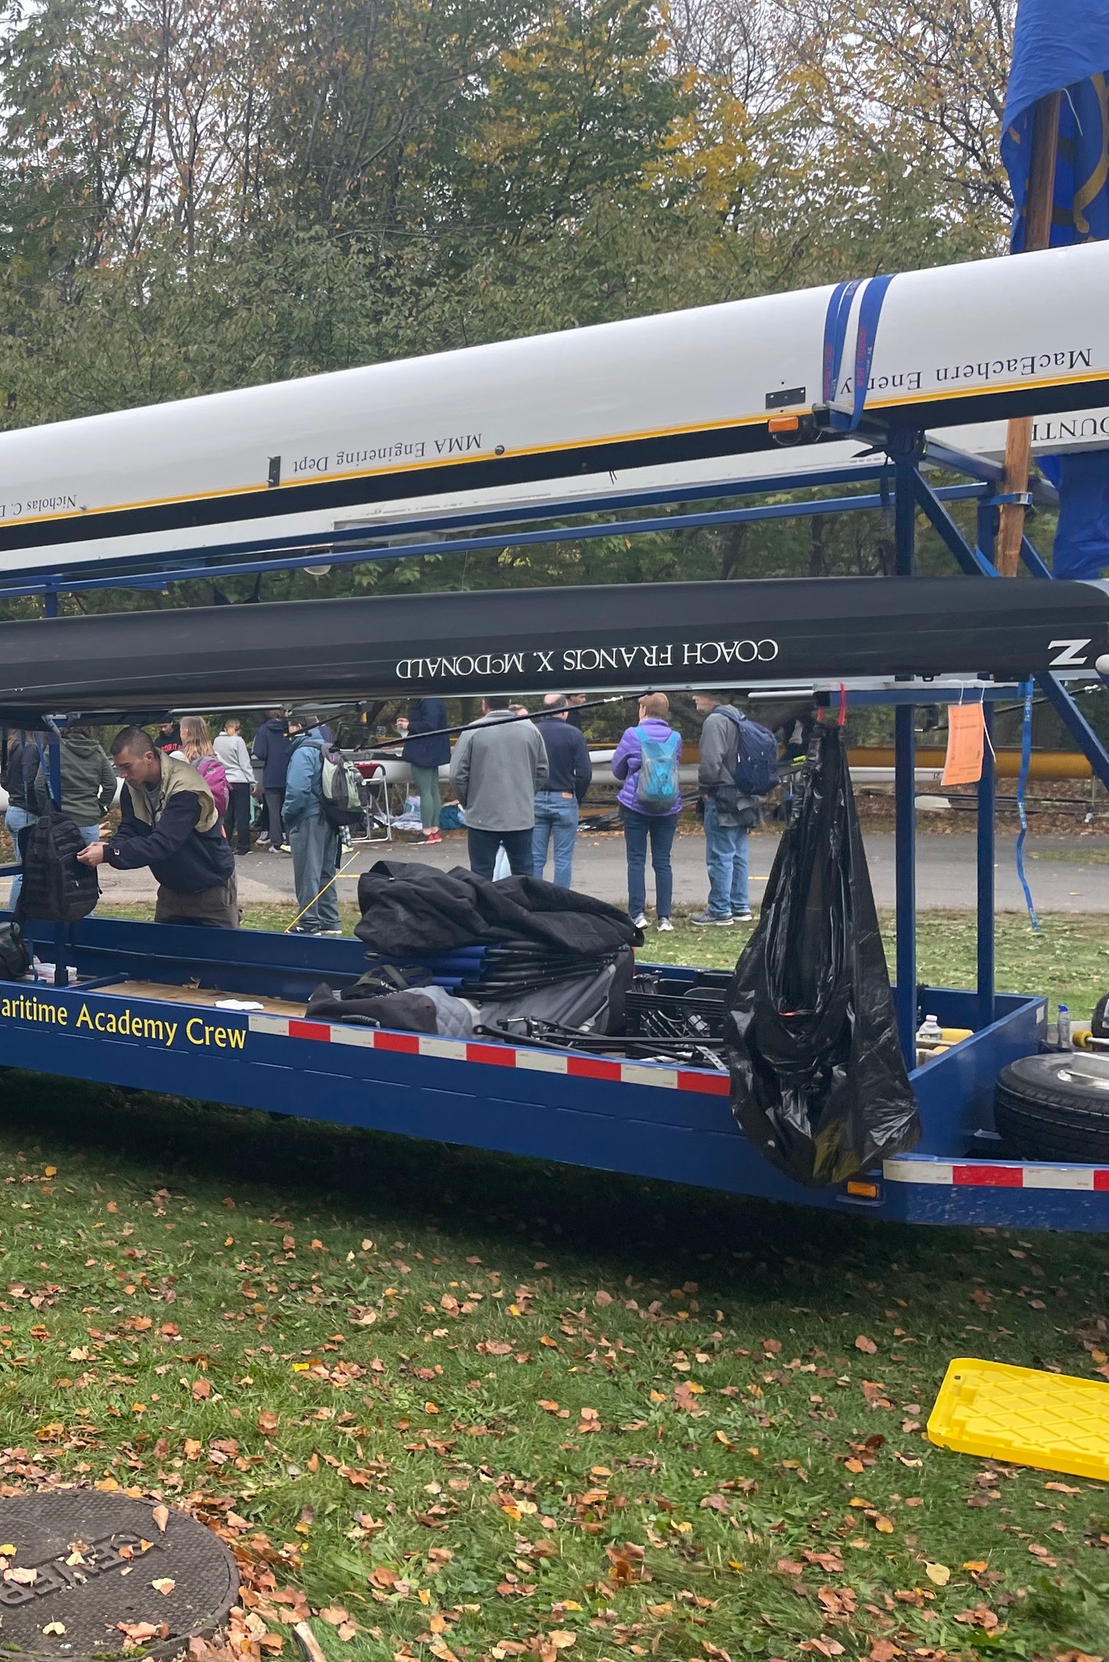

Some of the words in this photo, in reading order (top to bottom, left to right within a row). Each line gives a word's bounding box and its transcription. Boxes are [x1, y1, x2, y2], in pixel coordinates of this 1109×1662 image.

[935, 348, 1092, 383] MacEachern
[840, 371, 922, 396] Enery
[1031, 416, 1109, 442] OUNT
[335, 442, 426, 467] Enginering
[434, 433, 483, 454] MMA
[292, 455, 329, 474] Dept
[11, 502, 23, 516] C.
[26, 494, 77, 512] Nicholas
[533, 651, 554, 672] X.
[562, 644, 673, 671] FRANCIS
[682, 638, 779, 665] COACH
[1047, 638, 1092, 666] Z
[75, 1003, 178, 1047] Academy
[185, 1017, 247, 1050] Crew
